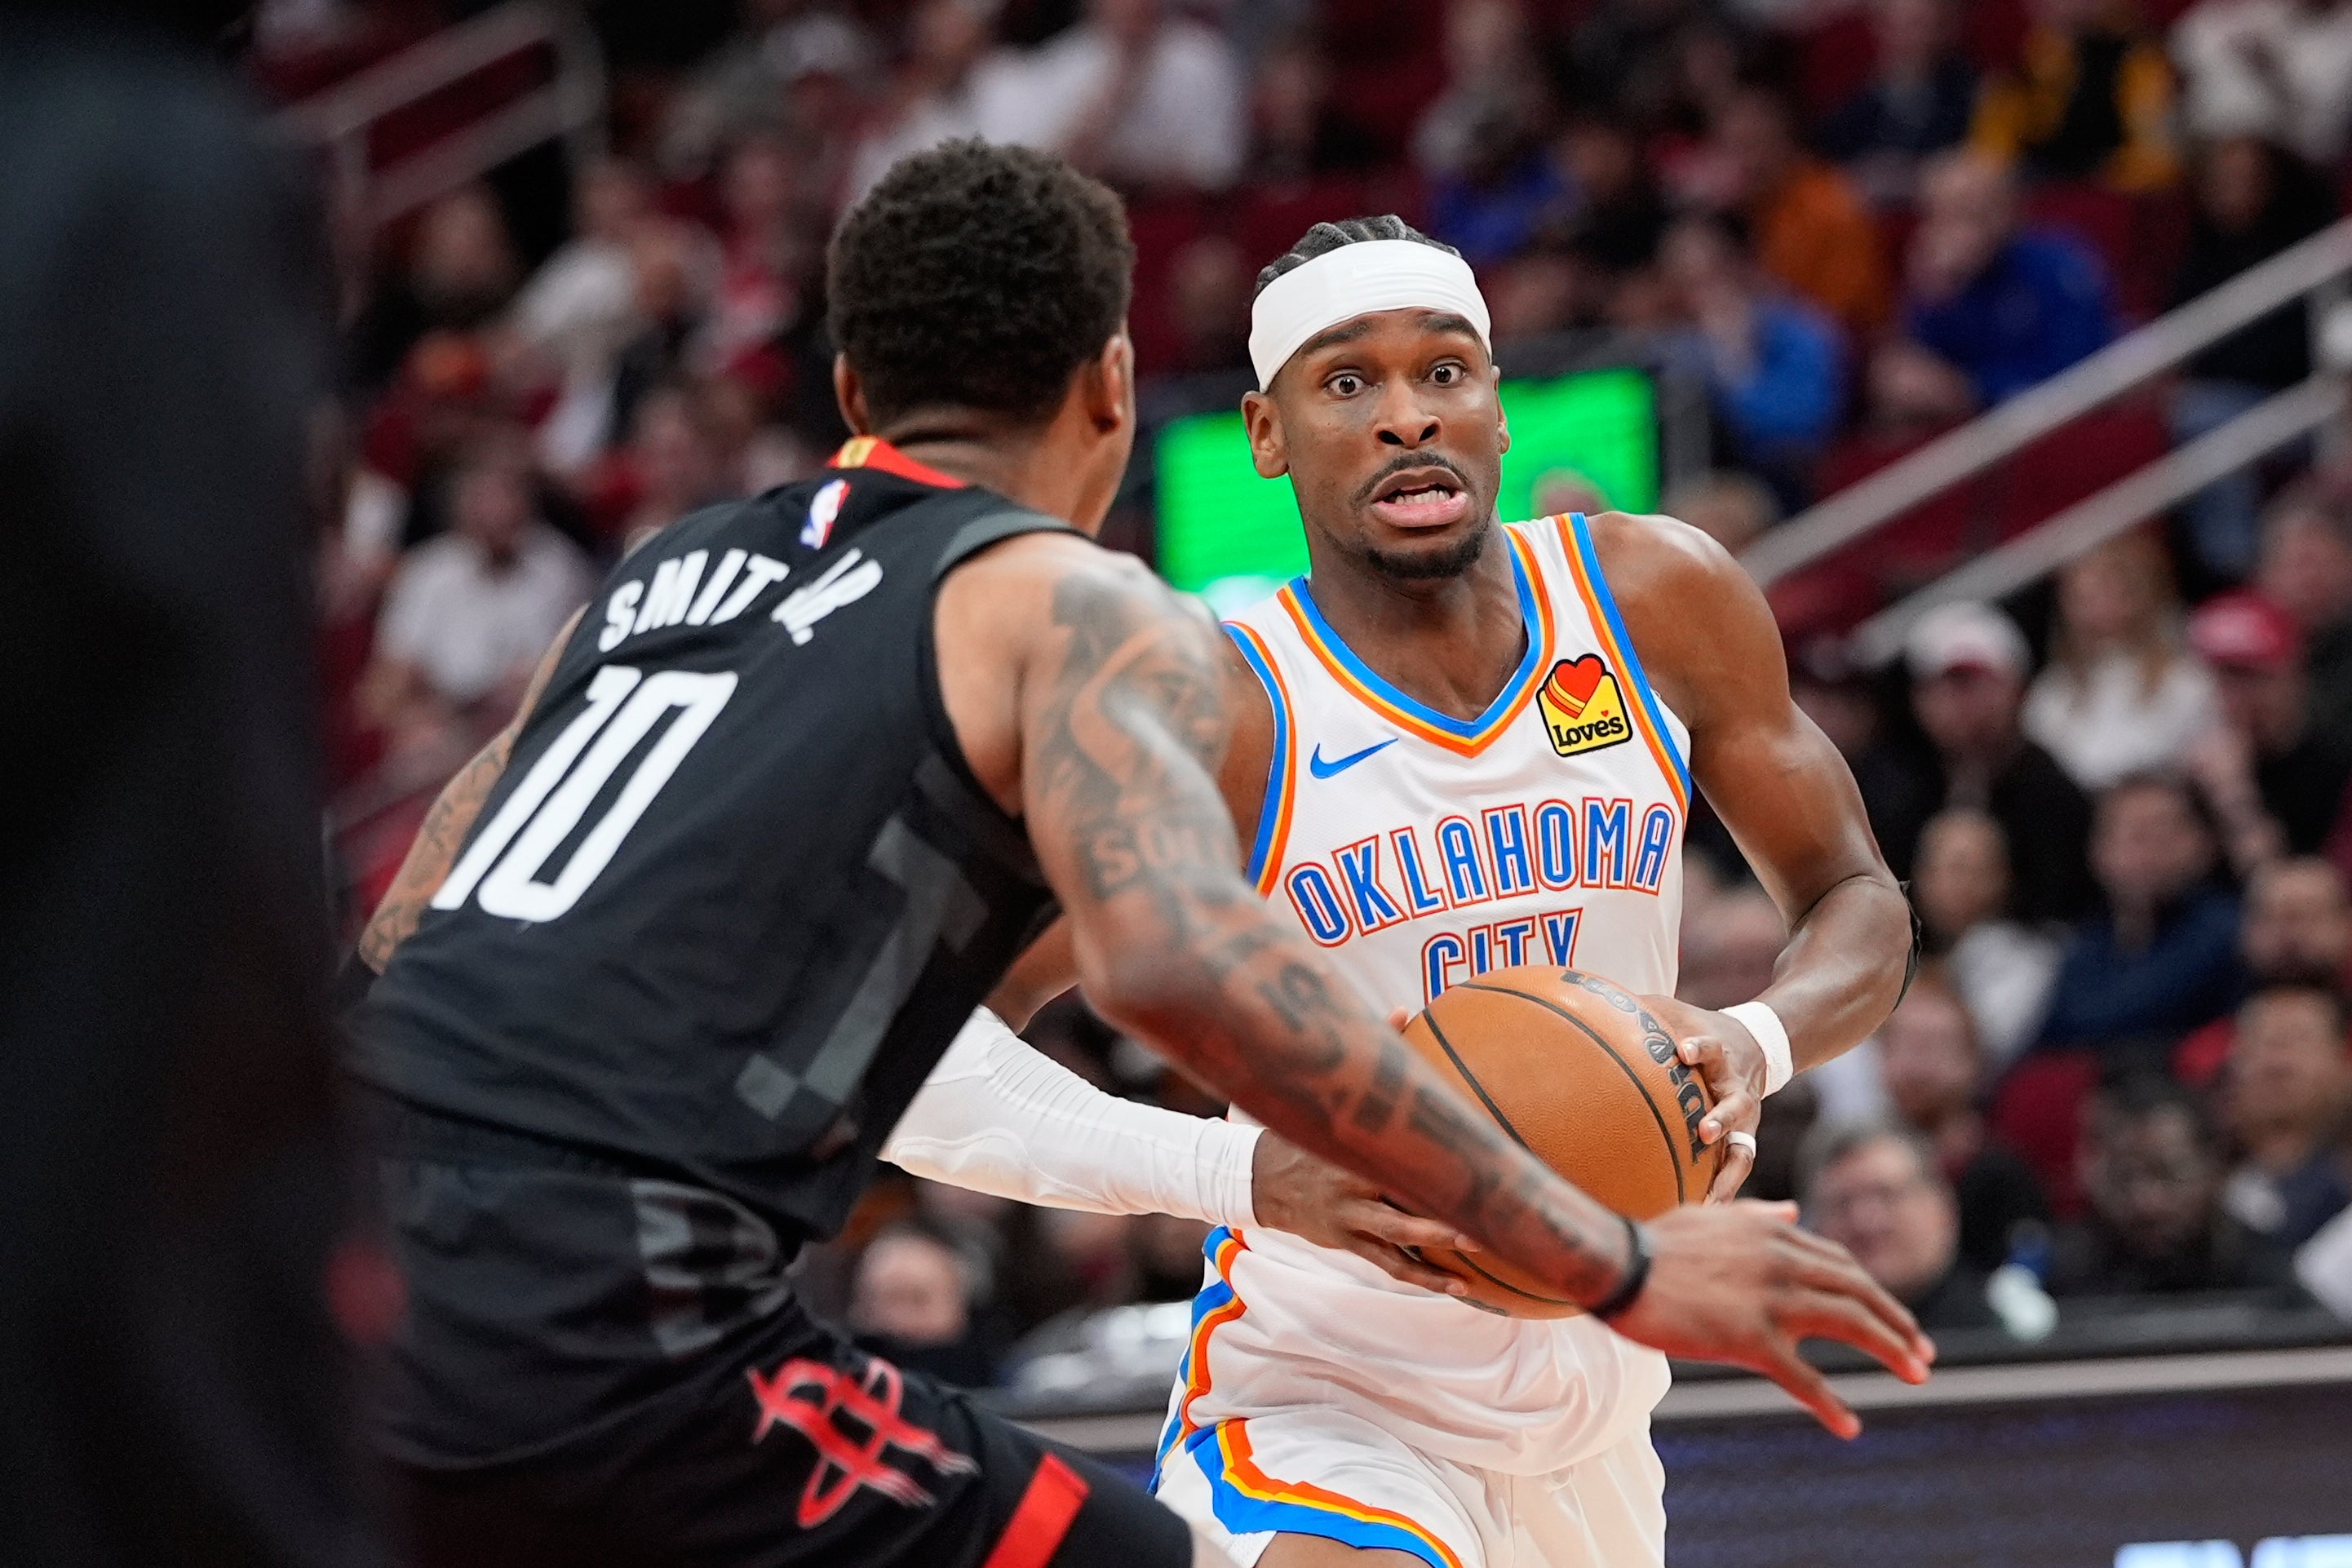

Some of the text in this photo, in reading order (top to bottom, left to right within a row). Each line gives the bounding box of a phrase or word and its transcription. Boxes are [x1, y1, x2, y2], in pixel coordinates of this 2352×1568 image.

[598, 547, 790, 652] SMIT
[430, 664, 739, 923] 10
[1284, 796, 1675, 948] OKLAHOMA
